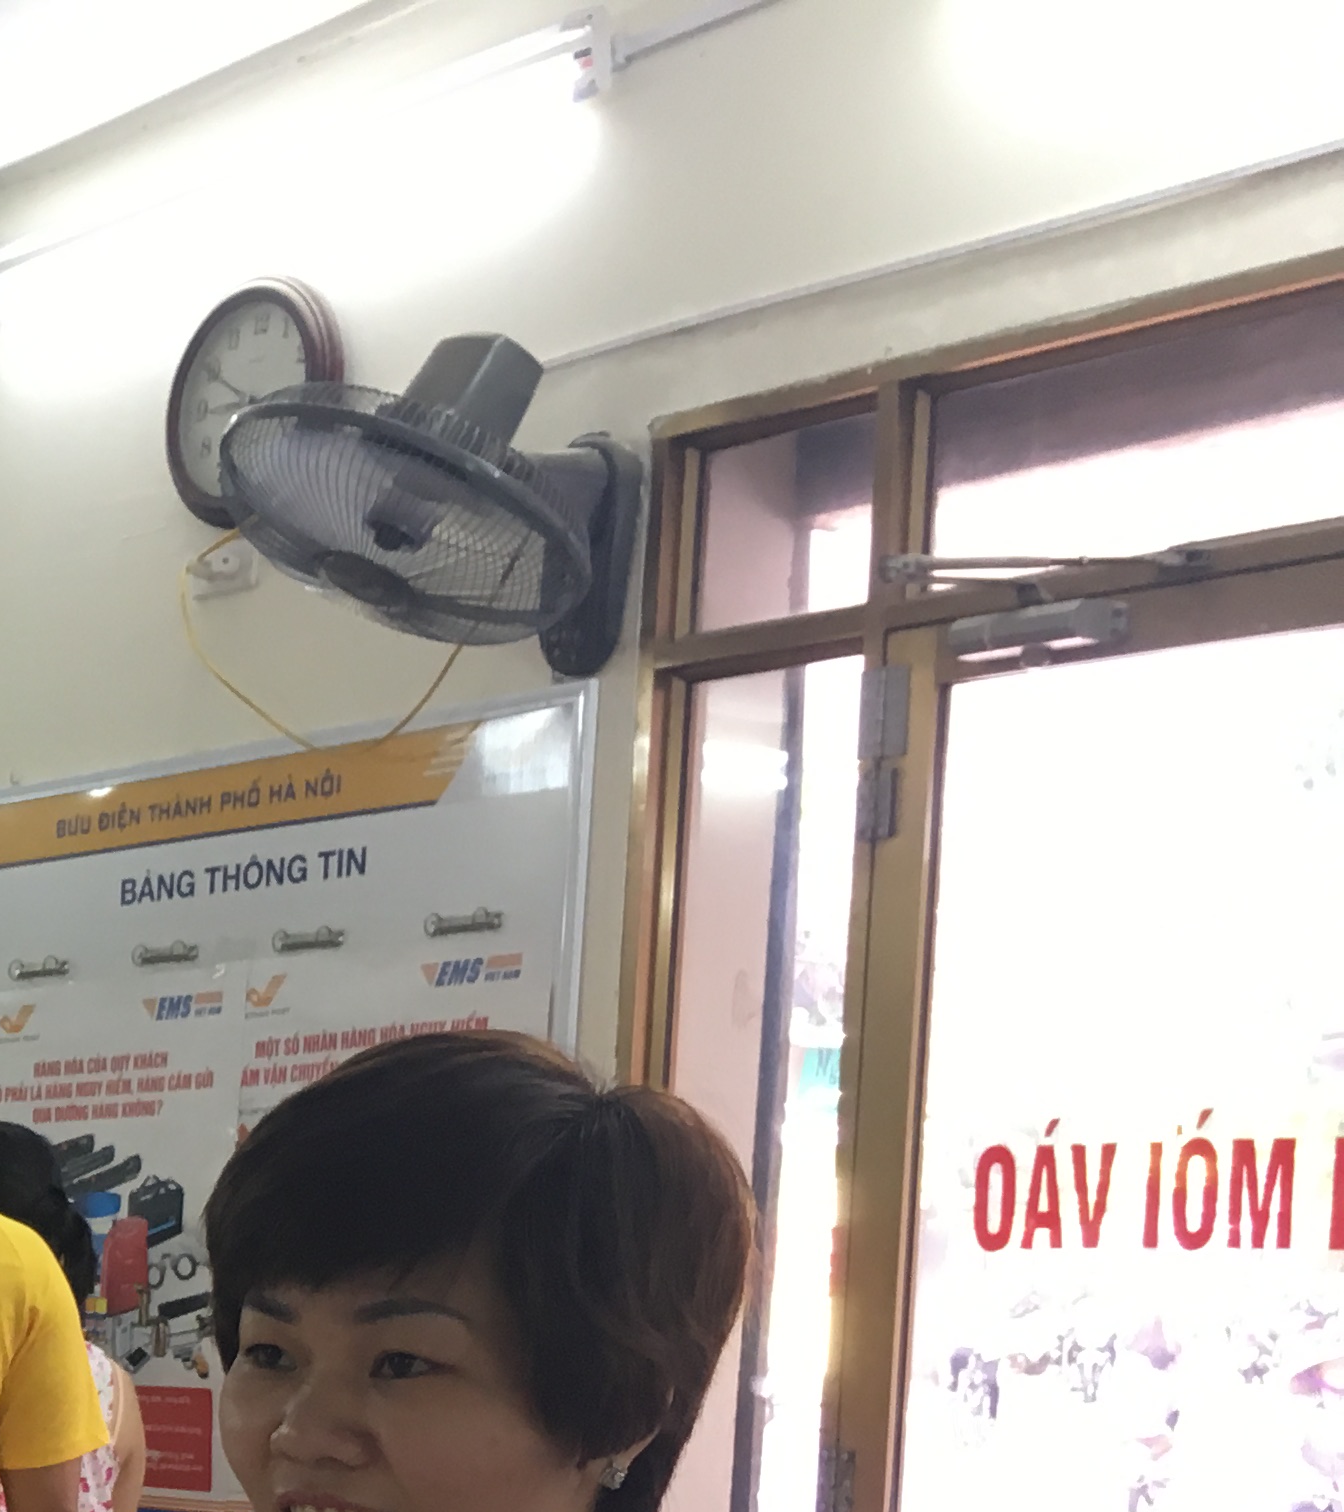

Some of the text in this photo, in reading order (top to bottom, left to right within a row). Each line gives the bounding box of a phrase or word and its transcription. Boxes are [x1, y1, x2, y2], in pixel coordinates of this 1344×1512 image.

[56, 768, 342, 839] BƯU ĐIỆN THÀNH PHỐ HÀ NỘI
[120, 846, 368, 907] BẢNG THÔNG TIN
[434, 957, 484, 988] EMS
[156, 994, 194, 1021] EMS
[255, 1035, 281, 1061] MỘT
[283, 1030, 300, 1056] SỐ
